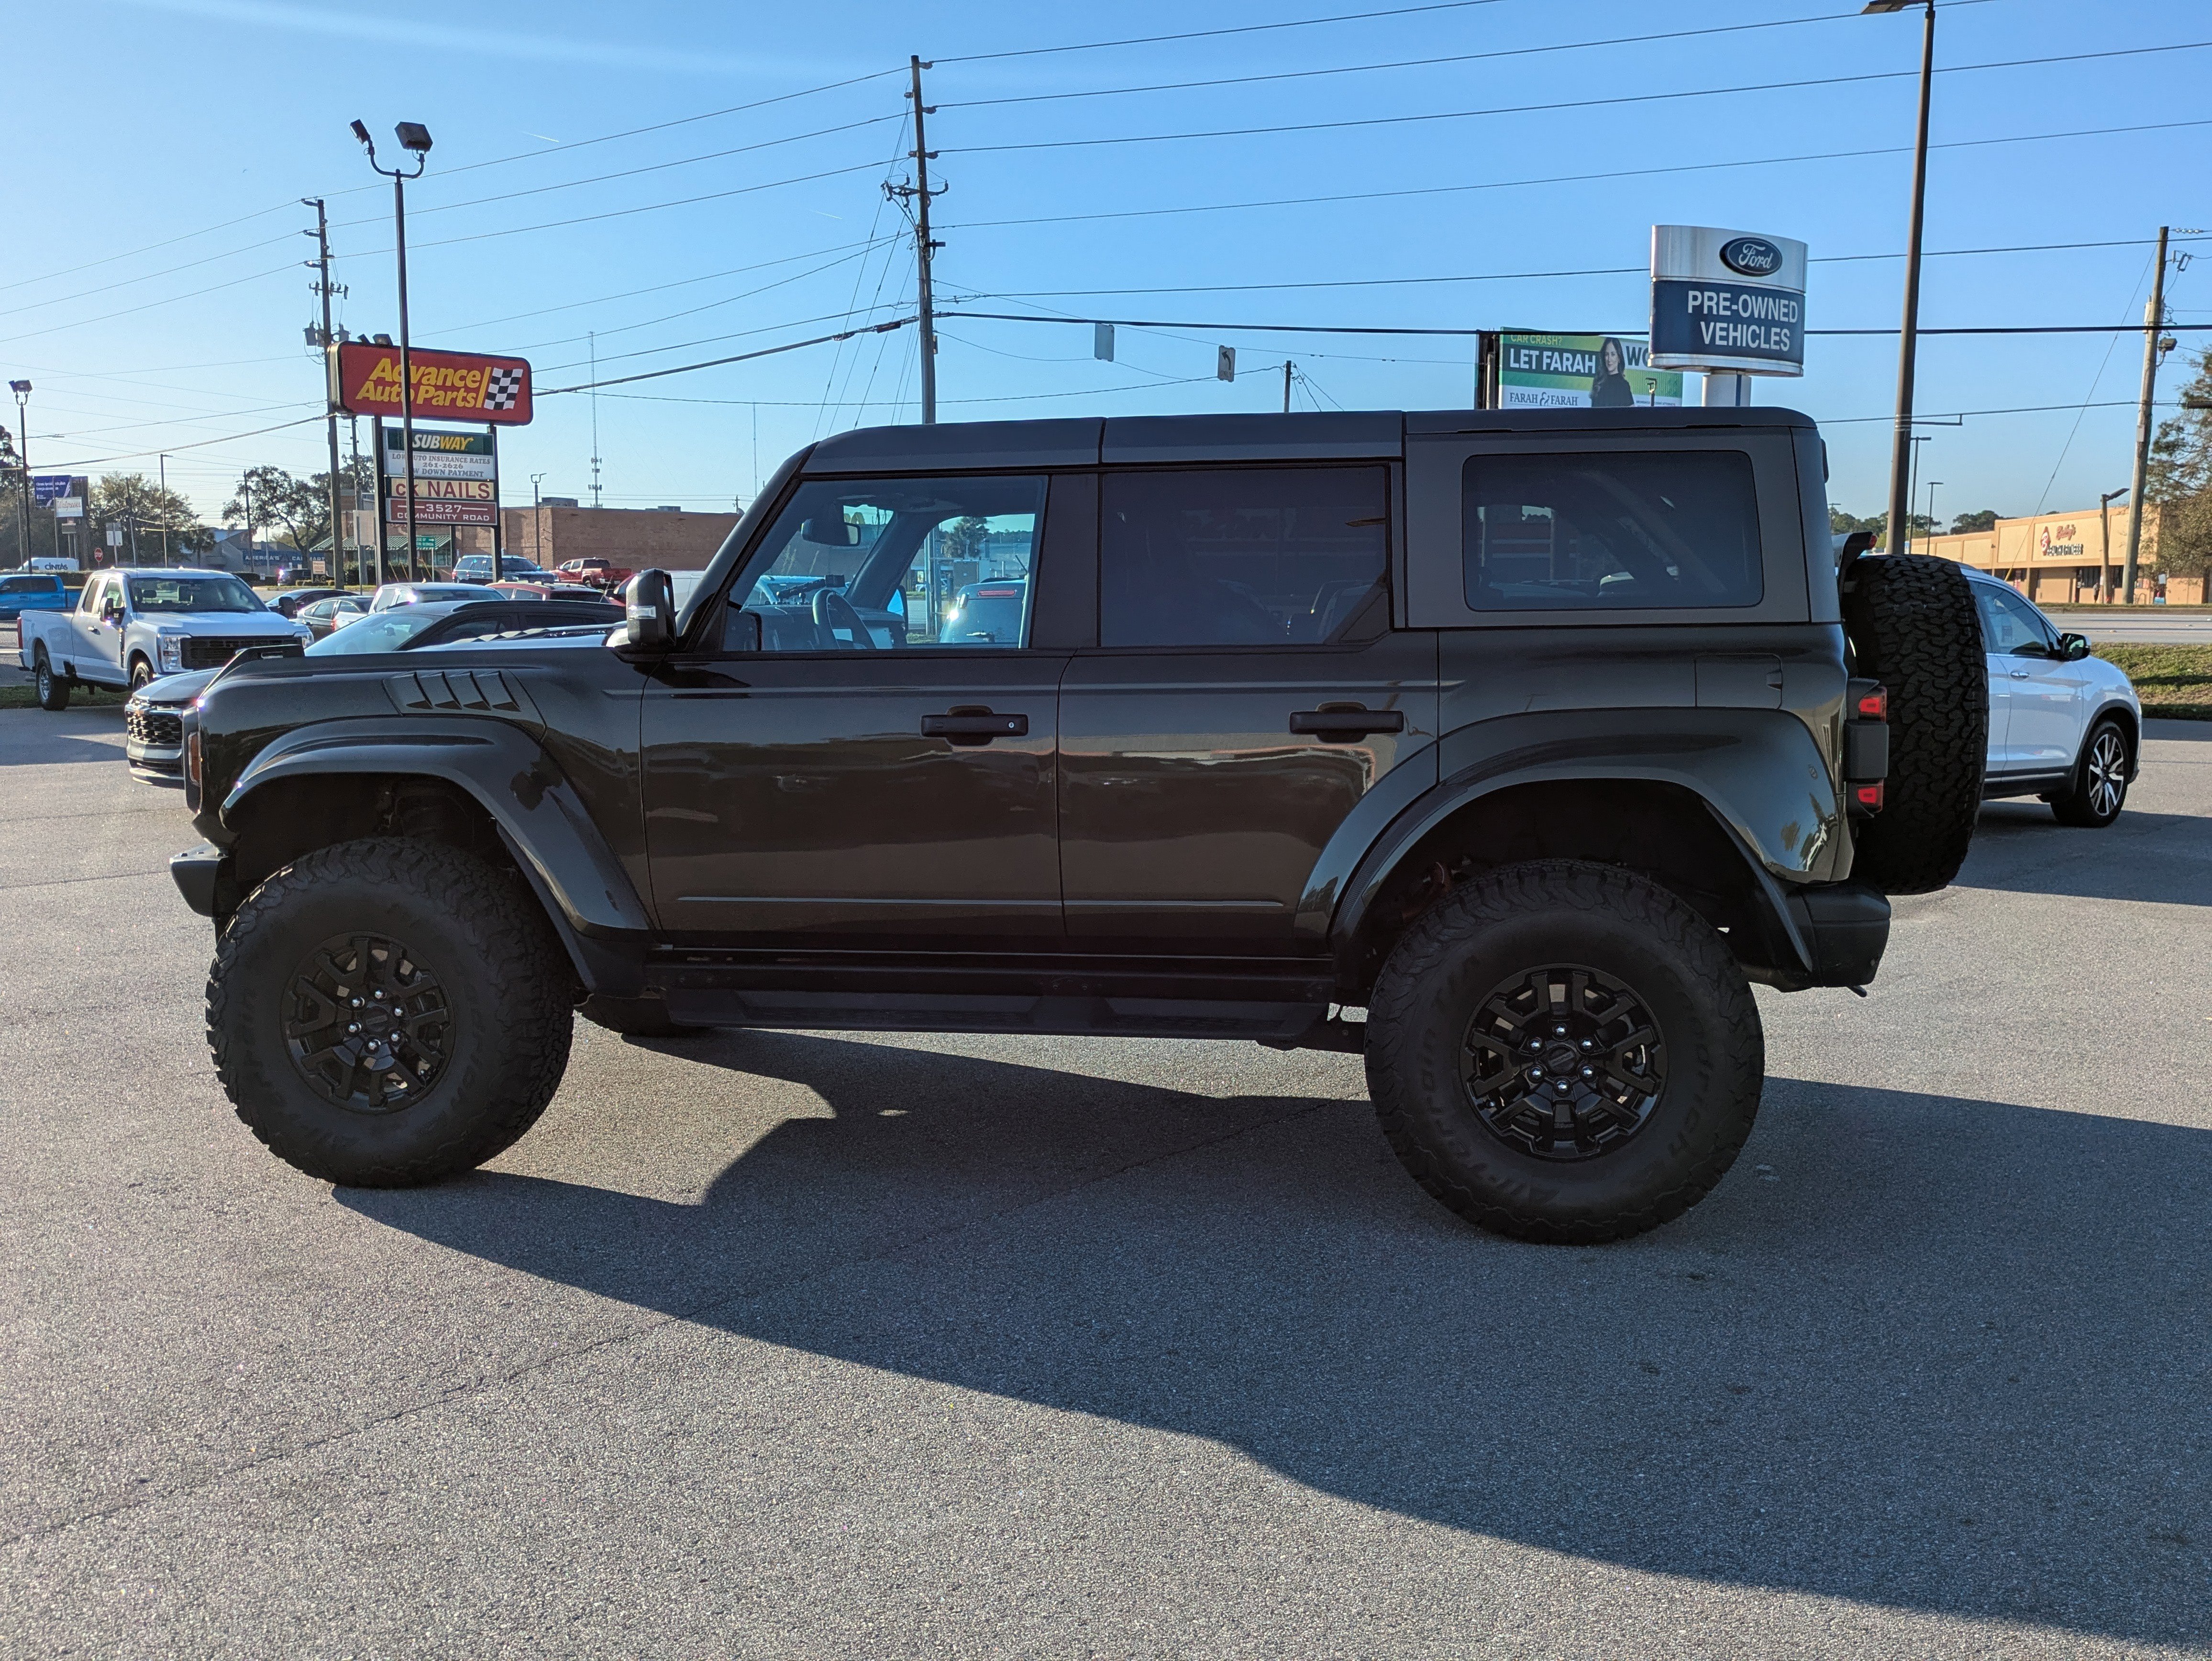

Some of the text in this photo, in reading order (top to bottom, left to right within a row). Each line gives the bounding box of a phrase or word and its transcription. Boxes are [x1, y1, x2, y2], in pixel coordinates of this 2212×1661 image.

[1738, 243, 1773, 269] Ford
[1688, 290, 1798, 323] PRE-OWNED
[1510, 334, 1562, 346] CAR CRASH?
[1700, 321, 1791, 352] VEHICLES
[1510, 348, 1596, 375] LET FARAH
[369, 358, 481, 388] Advance
[416, 386, 477, 408] Parts
[1510, 391, 1578, 406] FARAH & FARAH
[412, 434, 474, 451] SUBWAY
[428, 481, 490, 499] NAILS
[426, 504, 462, 513] 3527
